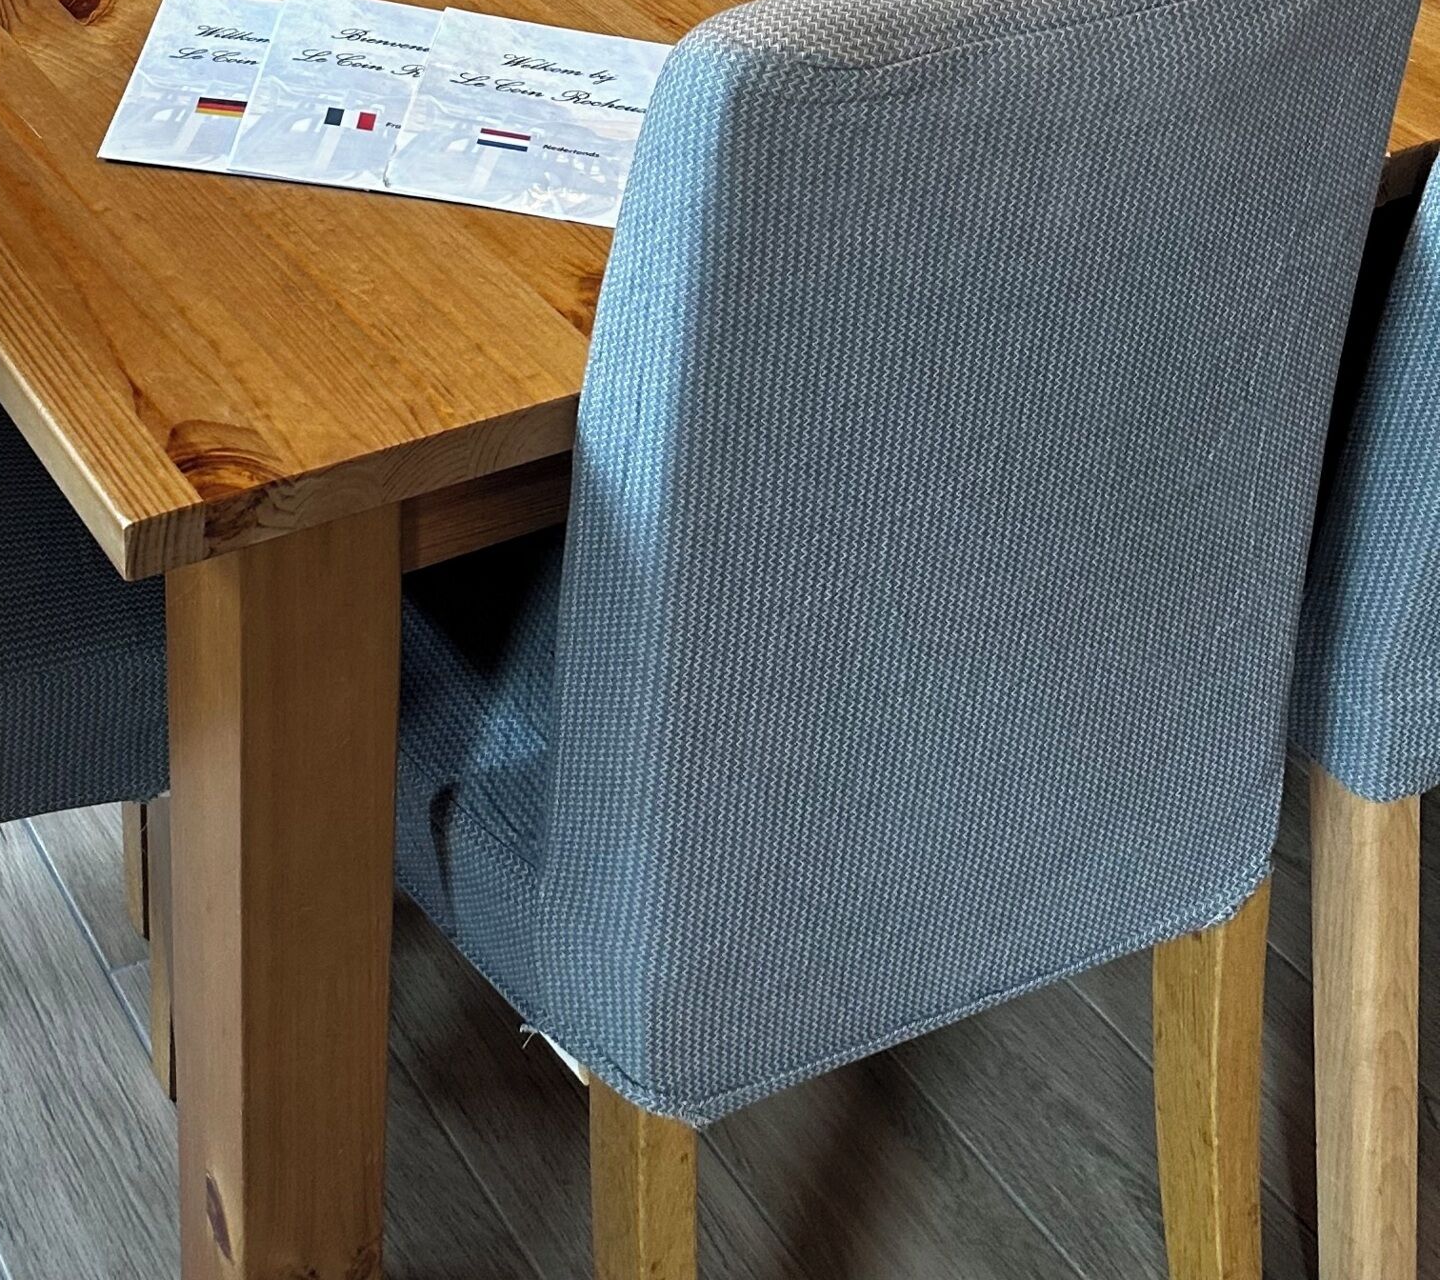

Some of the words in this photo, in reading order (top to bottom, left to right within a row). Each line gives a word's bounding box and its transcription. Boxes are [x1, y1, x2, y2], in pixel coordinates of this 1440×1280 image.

[168, 47, 209, 61] Le
[211, 49, 260, 66] Coin
[292, 48, 329, 64] Le
[335, 52, 385, 72] Coin
[501, 52, 584, 76] Welkom
[588, 69, 618, 86] bij
[449, 72, 491, 88] Le
[493, 78, 545, 98] Coin
[542, 144, 601, 158] Nederlands
